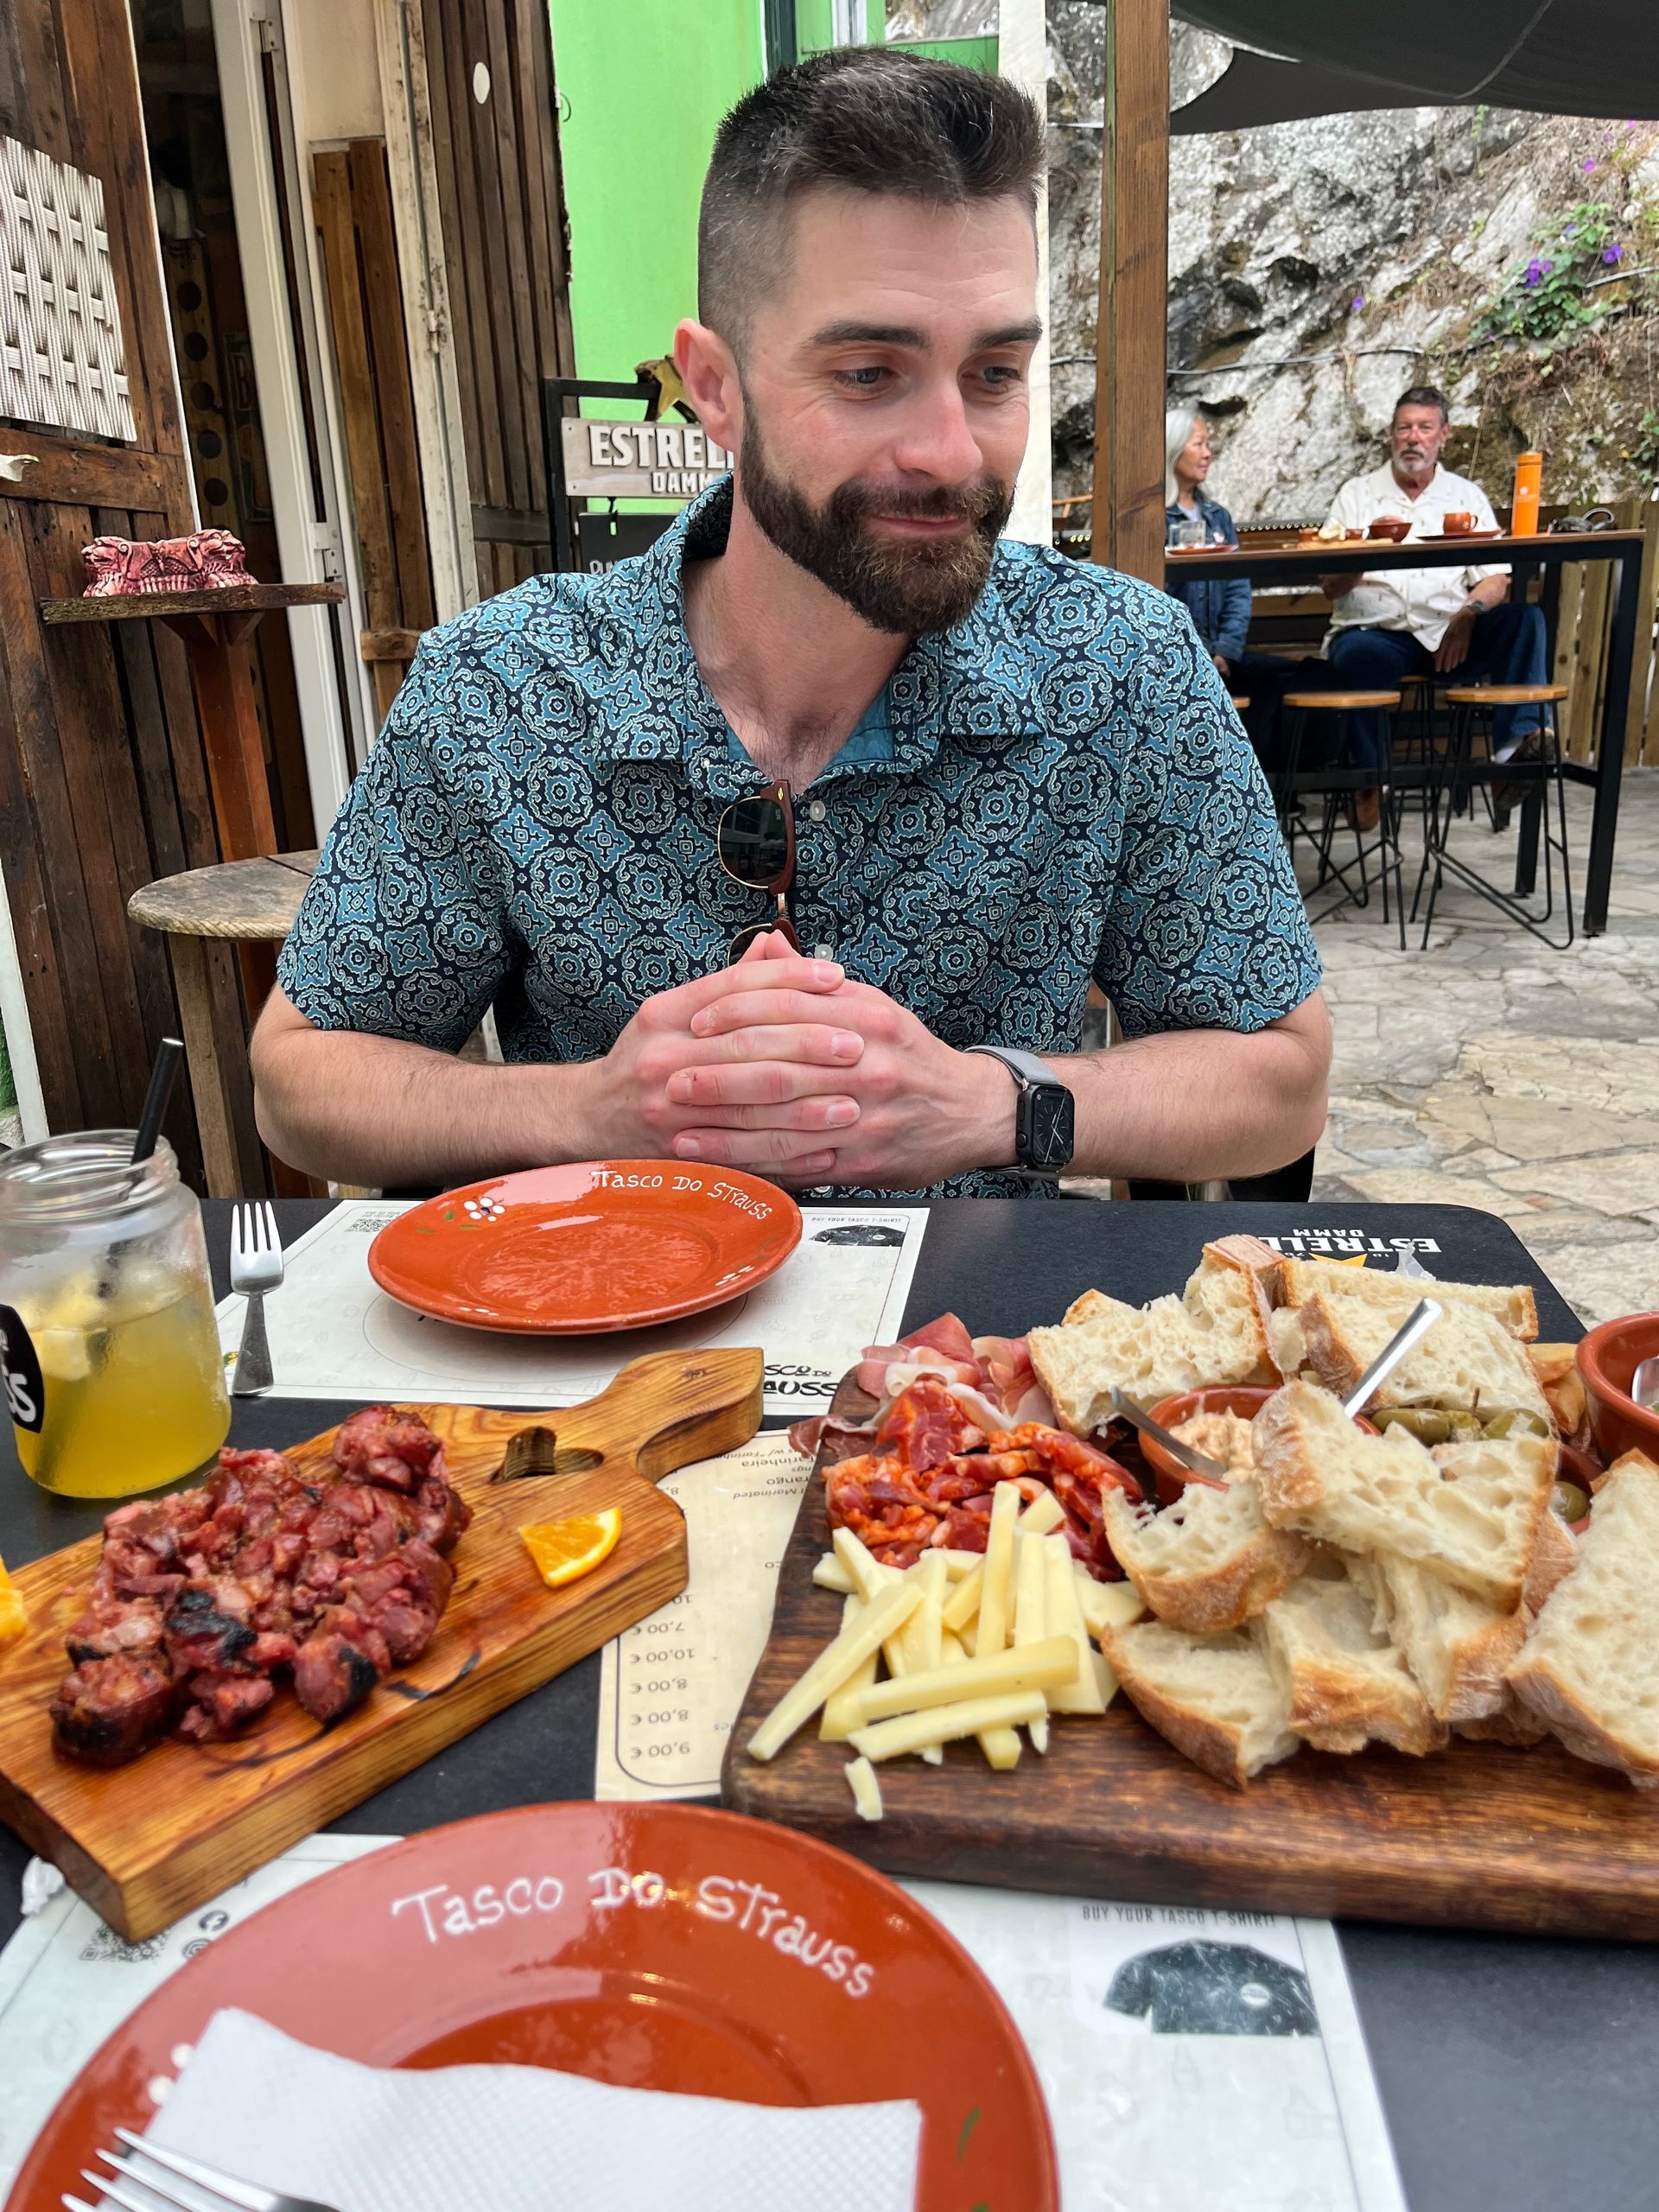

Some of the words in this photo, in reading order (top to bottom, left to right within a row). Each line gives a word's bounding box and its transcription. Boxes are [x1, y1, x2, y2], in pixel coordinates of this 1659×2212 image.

[1293, 1229, 1365, 1237] DAMM
[1258, 1236, 1442, 1253] ESTRELL
[765, 1364, 810, 1376] SCO
[764, 1381, 839, 1396] AUSS
[766, 1476, 810, 1485] rango
[733, 1488, 796, 1500] Marinated
[646, 1648, 696, 1662] 10,00
[648, 1678, 688, 1693] 8,00
[648, 1709, 689, 1724] 8,00
[1083, 1904, 1109, 1921] BUY
[1116, 1906, 1154, 1923] YOUR
[1161, 1908, 1206, 1926] TASCO
[1212, 1910, 1278, 1929] T-SHIRT!
